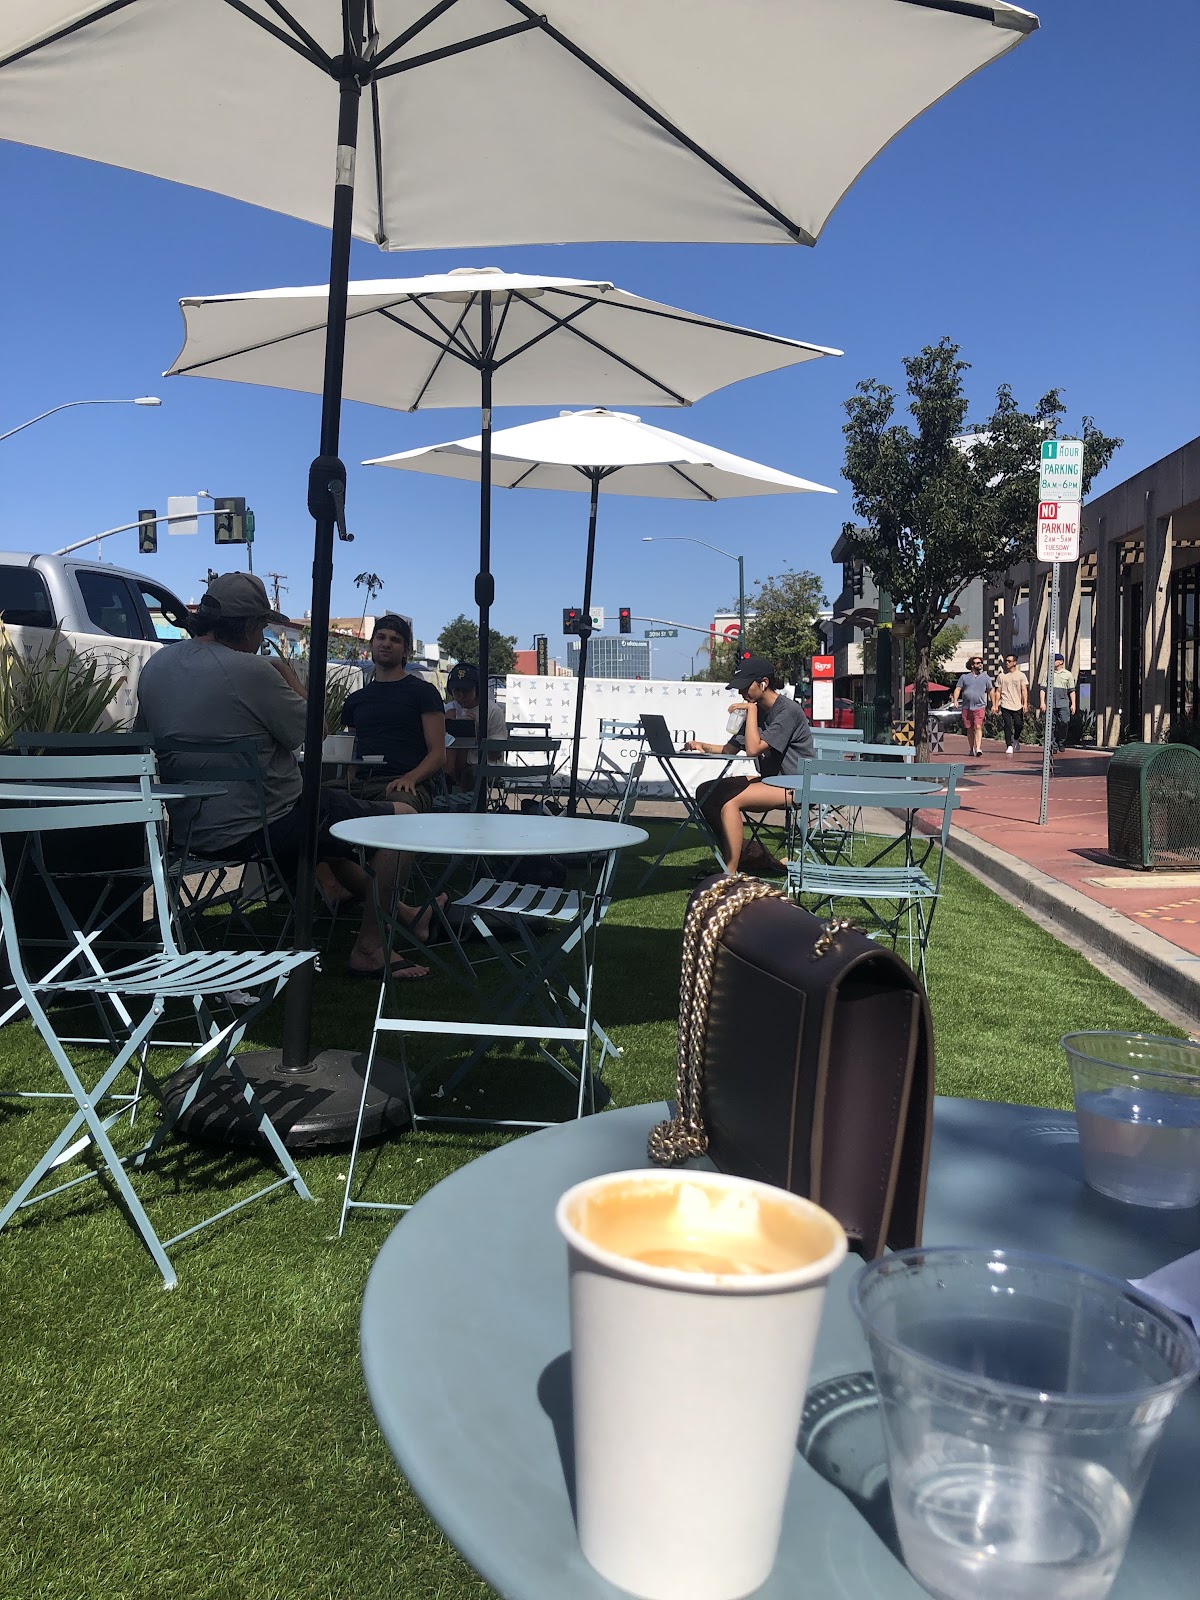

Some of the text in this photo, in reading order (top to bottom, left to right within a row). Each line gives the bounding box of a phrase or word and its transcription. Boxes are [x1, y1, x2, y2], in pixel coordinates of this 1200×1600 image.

[1047, 443, 1079, 457] 1 HOUR
[1044, 463, 1079, 475] PARKING
[1041, 504, 1056, 518] NO
[1041, 522, 1077, 534] PARKING
